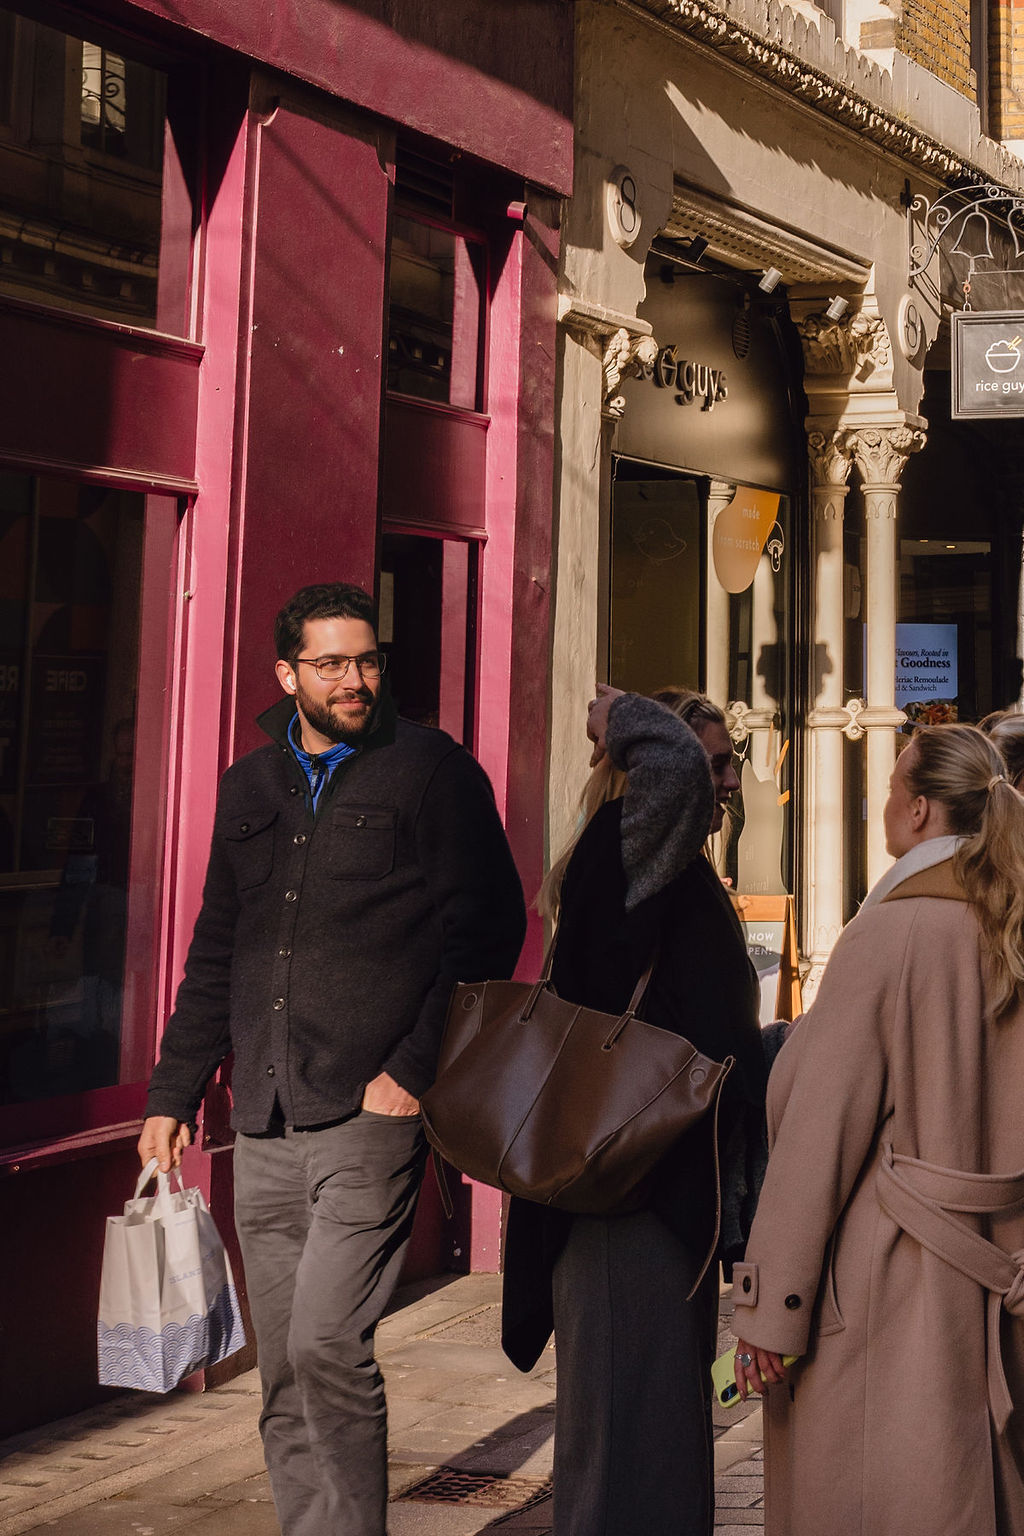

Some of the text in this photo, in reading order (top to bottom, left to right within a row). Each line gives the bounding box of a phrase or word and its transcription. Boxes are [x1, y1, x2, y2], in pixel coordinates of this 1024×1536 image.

[674, 361, 728, 412] guys
[975, 380, 999, 392] rice
[901, 657, 951, 668] Goodness
[908, 684, 937, 692] Sandwich
